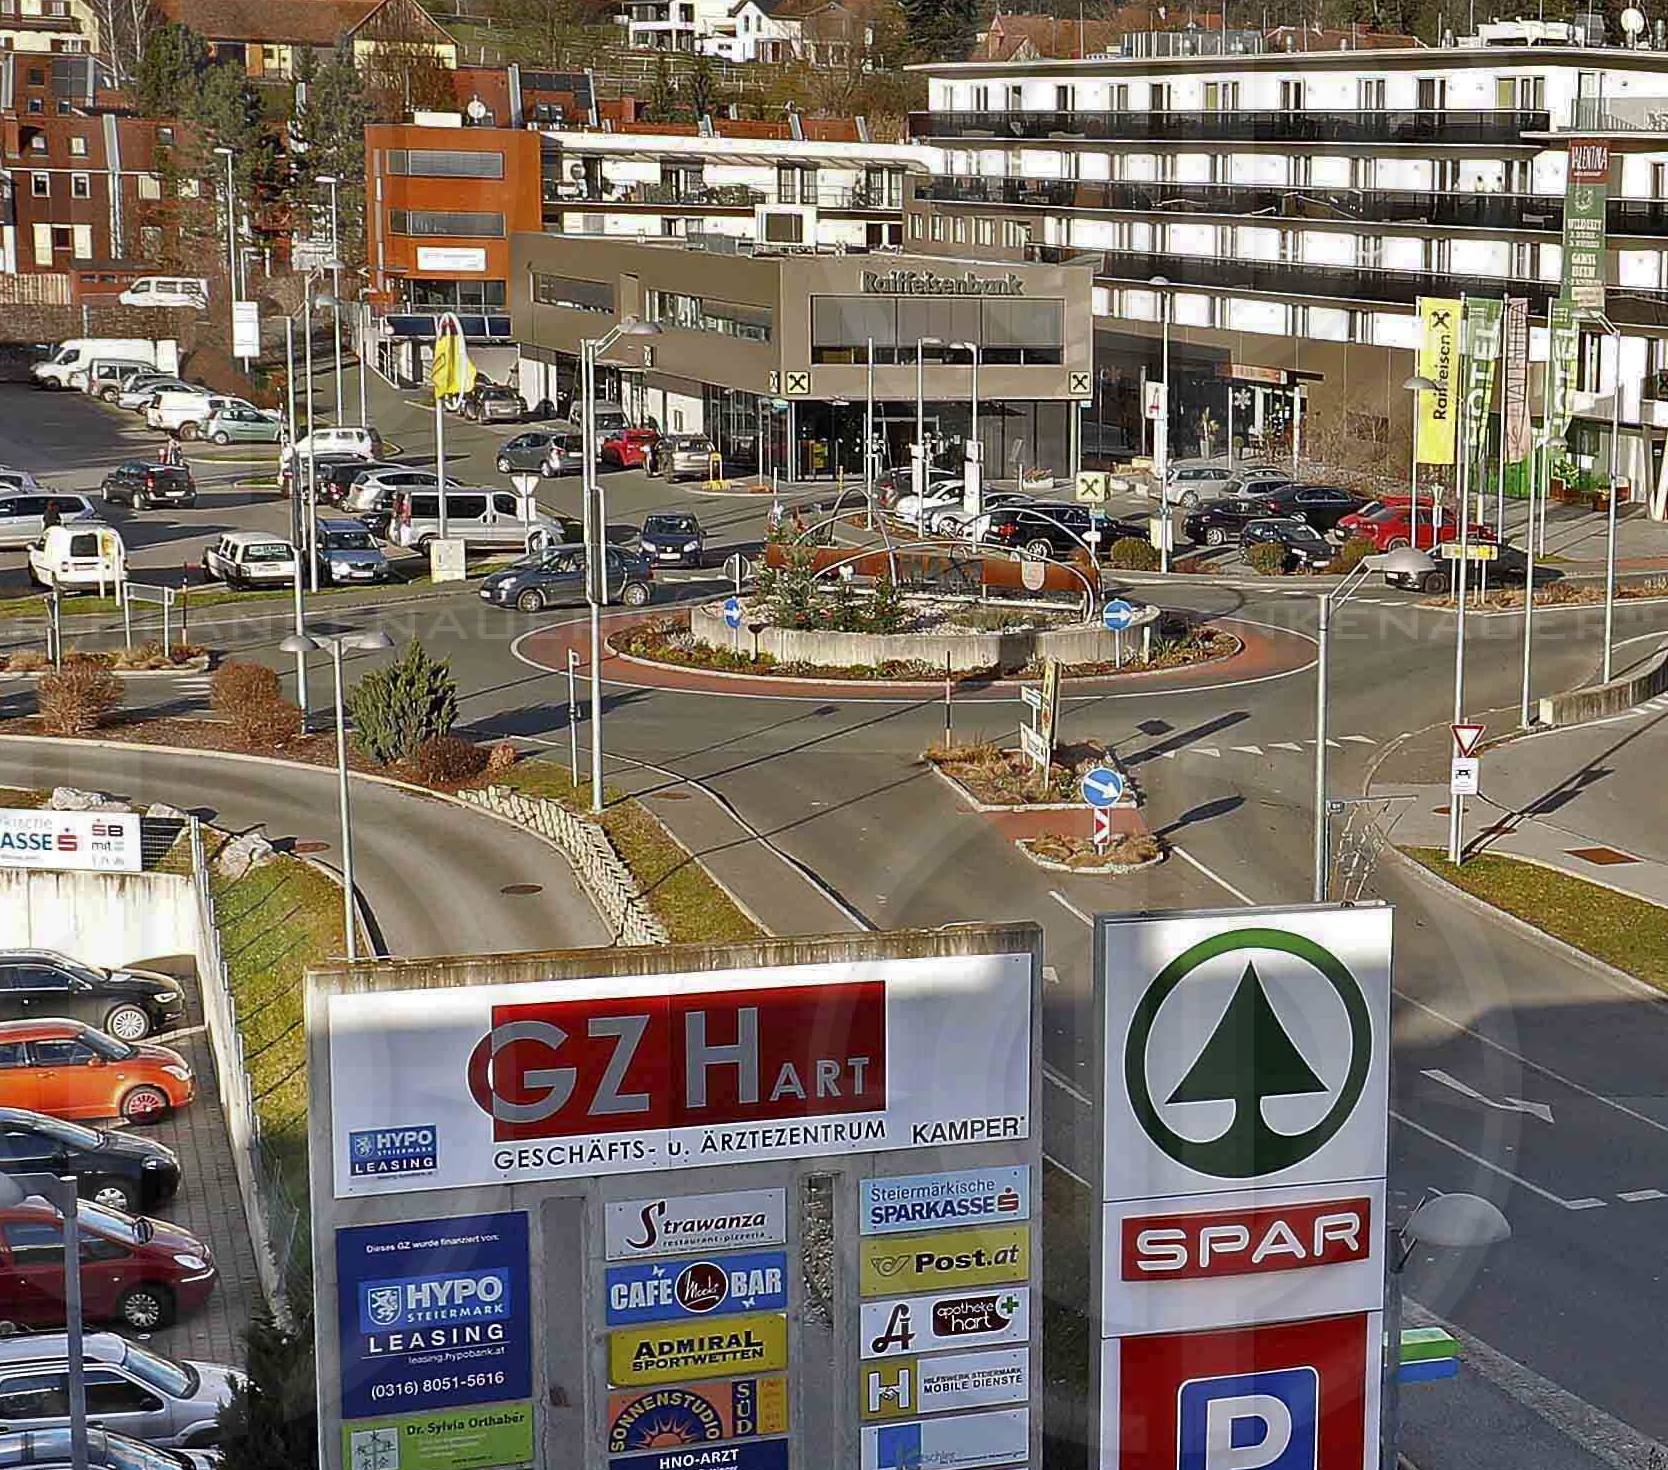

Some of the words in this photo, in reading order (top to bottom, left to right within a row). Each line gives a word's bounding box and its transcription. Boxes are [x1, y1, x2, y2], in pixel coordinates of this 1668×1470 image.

[860, 269, 1028, 295] Raiffeisenbank
[487, 1014, 651, 1125] GZ
[684, 1006, 870, 1110] HART
[376, 1130, 432, 1148] HYPO
[493, 1139, 657, 1171] GESCHÄFTS-
[667, 1136, 690, 1158] u.
[700, 1119, 887, 1155] ÄRZTEZENTRUM
[912, 1119, 1020, 1145] KAMPER
[355, 1157, 434, 1174] LEASING
[871, 1179, 995, 1202] Steiermärkische
[871, 1196, 995, 1225] SPARKASSE
[626, 1201, 765, 1249] Strawanza
[366, 1243, 395, 1253] Dieses
[397, 1241, 411, 1250] GZ
[413, 1239, 439, 1249] wurde
[1136, 1212, 1361, 1272] SPAR
[915, 1244, 1019, 1273] Post.at
[407, 1276, 503, 1309] HYPO
[611, 1279, 673, 1310] CAFE
[732, 1268, 782, 1298] BAR
[407, 1303, 503, 1323] STEIERMARK
[937, 1302, 994, 1320] apotheke
[951, 1313, 992, 1331] hart
[370, 1323, 503, 1353] LEASING
[634, 1331, 763, 1360] ADMIRAL
[409, 1347, 505, 1365] leasing.hypobank.at
[633, 1348, 764, 1372] SPORTWETTEN
[371, 1380, 418, 1400] (0316)
[423, 1371, 505, 1393] 8051-5616
[924, 1377, 969, 1394] MOBILE
[973, 1374, 1022, 1389] DIENSTE
[611, 1392, 721, 1451] SONNENSTUDIO
[737, 1383, 753, 1435] SÜD
[407, 1424, 424, 1435] Dr.
[427, 1420, 465, 1434] Sylvia
[468, 1411, 525, 1429] Orthaber
[659, 1449, 739, 1470] HNO-ARZT
